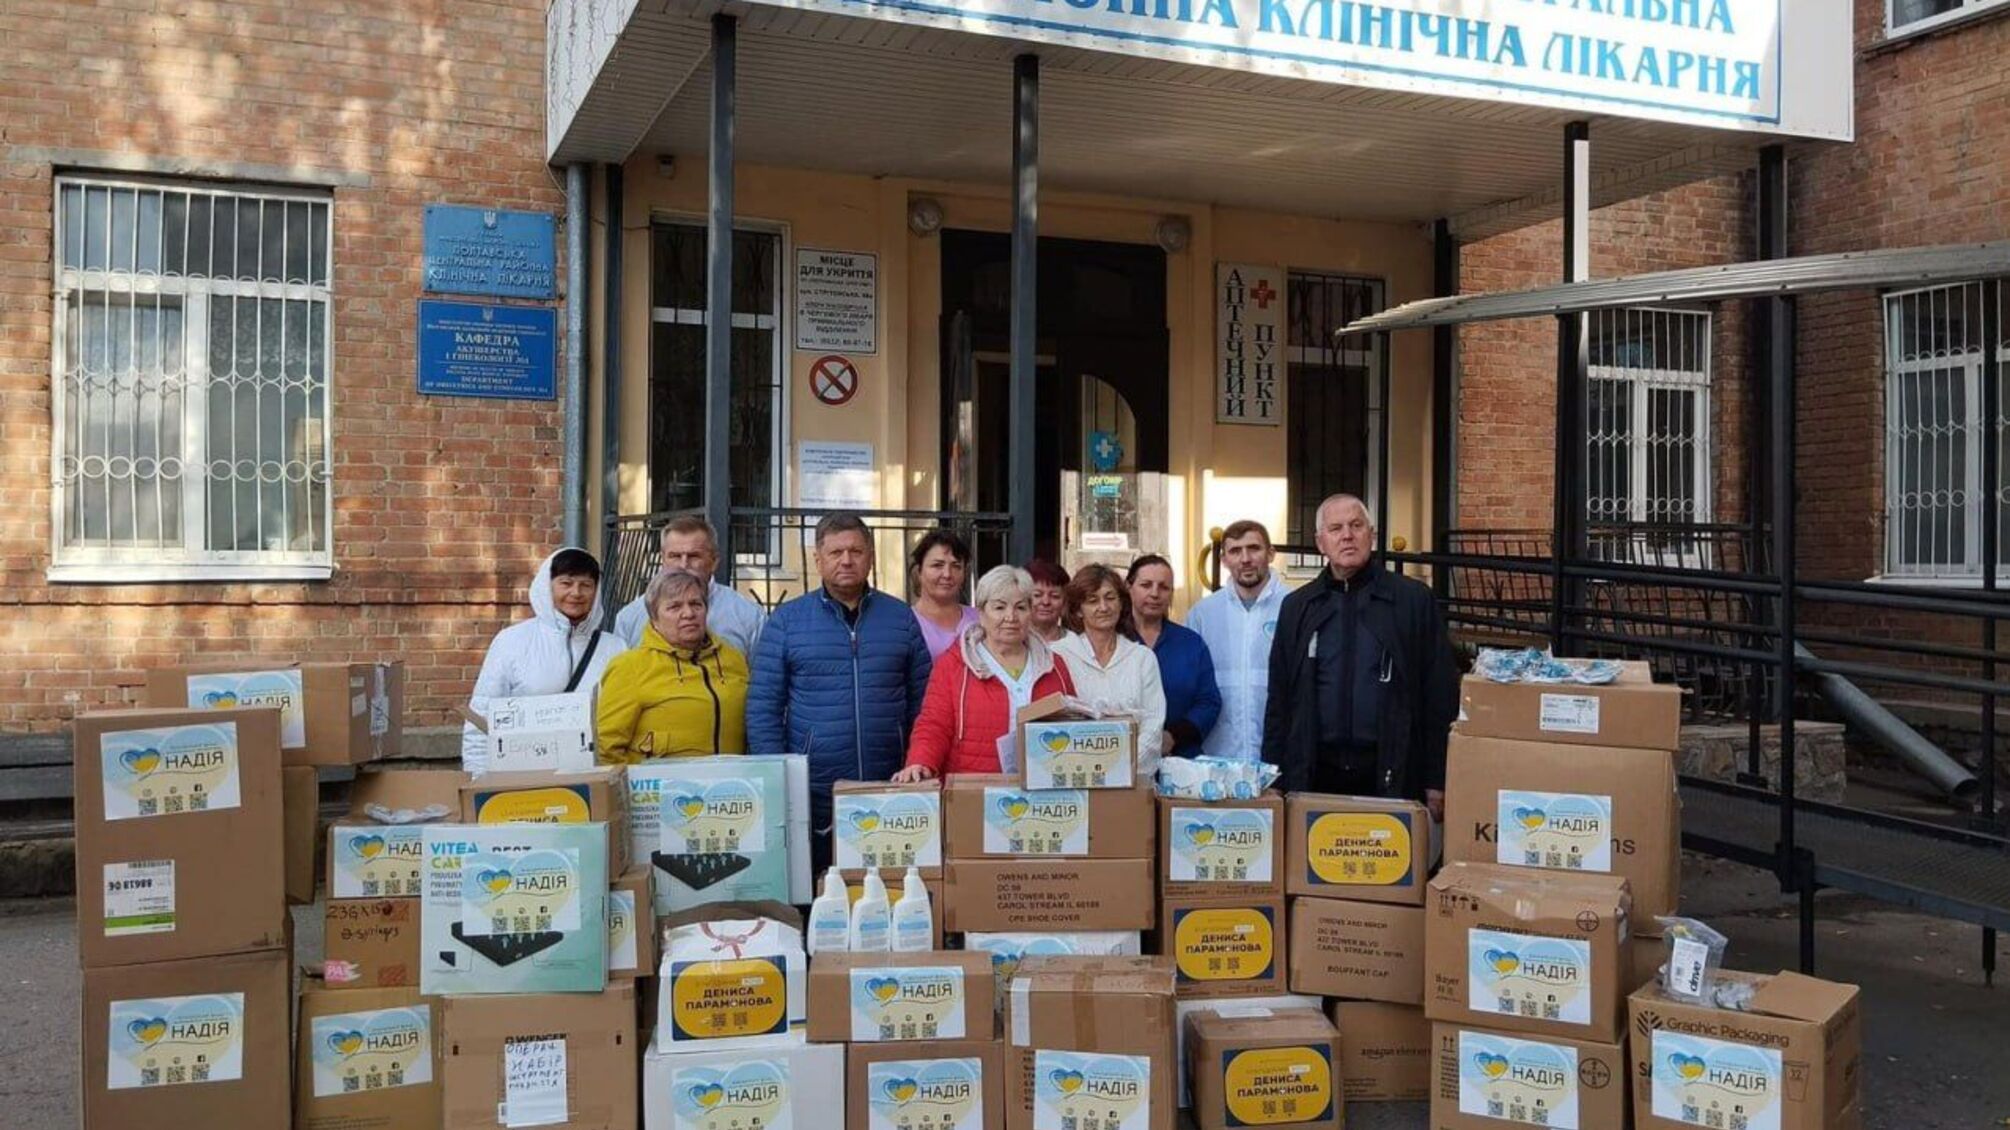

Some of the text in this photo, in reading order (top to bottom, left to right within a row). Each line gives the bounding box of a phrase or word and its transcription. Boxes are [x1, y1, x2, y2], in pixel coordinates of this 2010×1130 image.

[1543, 32, 1760, 99] ЛІКАРНЯ
[820, 256, 854, 267] МІСЦЕ
[800, 265, 873, 278] ДЛЯ УКРИТТЯ
[455, 332, 520, 346] КАФЕДРА
[1226, 268, 1245, 416] АПТЕЧНИЙ
[1254, 324, 1275, 417] ПУНКТ
[1073, 736, 1120, 750] НАДІЯ
[165, 751, 224, 769] НАДІЯ
[630, 779, 660, 790] VITE
[632, 792, 660, 803] CAR
[707, 802, 753, 815] НАДІЯ
[1032, 804, 1077, 818] НАДІЯ
[883, 816, 929, 831] НАДІЯ
[1549, 816, 1599, 832] НАДІЯ
[1217, 831, 1262, 845] НАДІЯ
[1335, 838, 1382, 848] ДЕНИСА
[387, 843, 422, 856] НАД
[1318, 848, 1399, 859] ПАРАМОНОВА
[431, 857, 462, 869] CAR
[516, 876, 567, 890] НАДІЯ
[1201, 933, 1246, 944] ДЕНИСА
[1185, 943, 1262, 955] ПАРАМОНОВА
[1523, 962, 1577, 980] НАДІЯ
[703, 987, 755, 999] ДЕНИСА
[902, 982, 953, 998] НАДІЯ
[685, 996, 773, 1011] ПАРАМОНОВА
[171, 1022, 229, 1039] НАДІЯ
[1667, 1017, 1790, 1048] Graphic Packaging
[367, 1032, 419, 1050] НАДІЯ
[1254, 1074, 1302, 1086] ДЕНИСА
[1512, 1066, 1565, 1086] НАДІЯ
[1709, 1069, 1767, 1091] НАДІЯ
[727, 1085, 779, 1103] НАДІЯ
[920, 1084, 970, 1099] НАДІЯ
[1087, 1080, 1138, 1096] НАДІЯ
[1237, 1084, 1319, 1097] ПАРАМОНОВА
